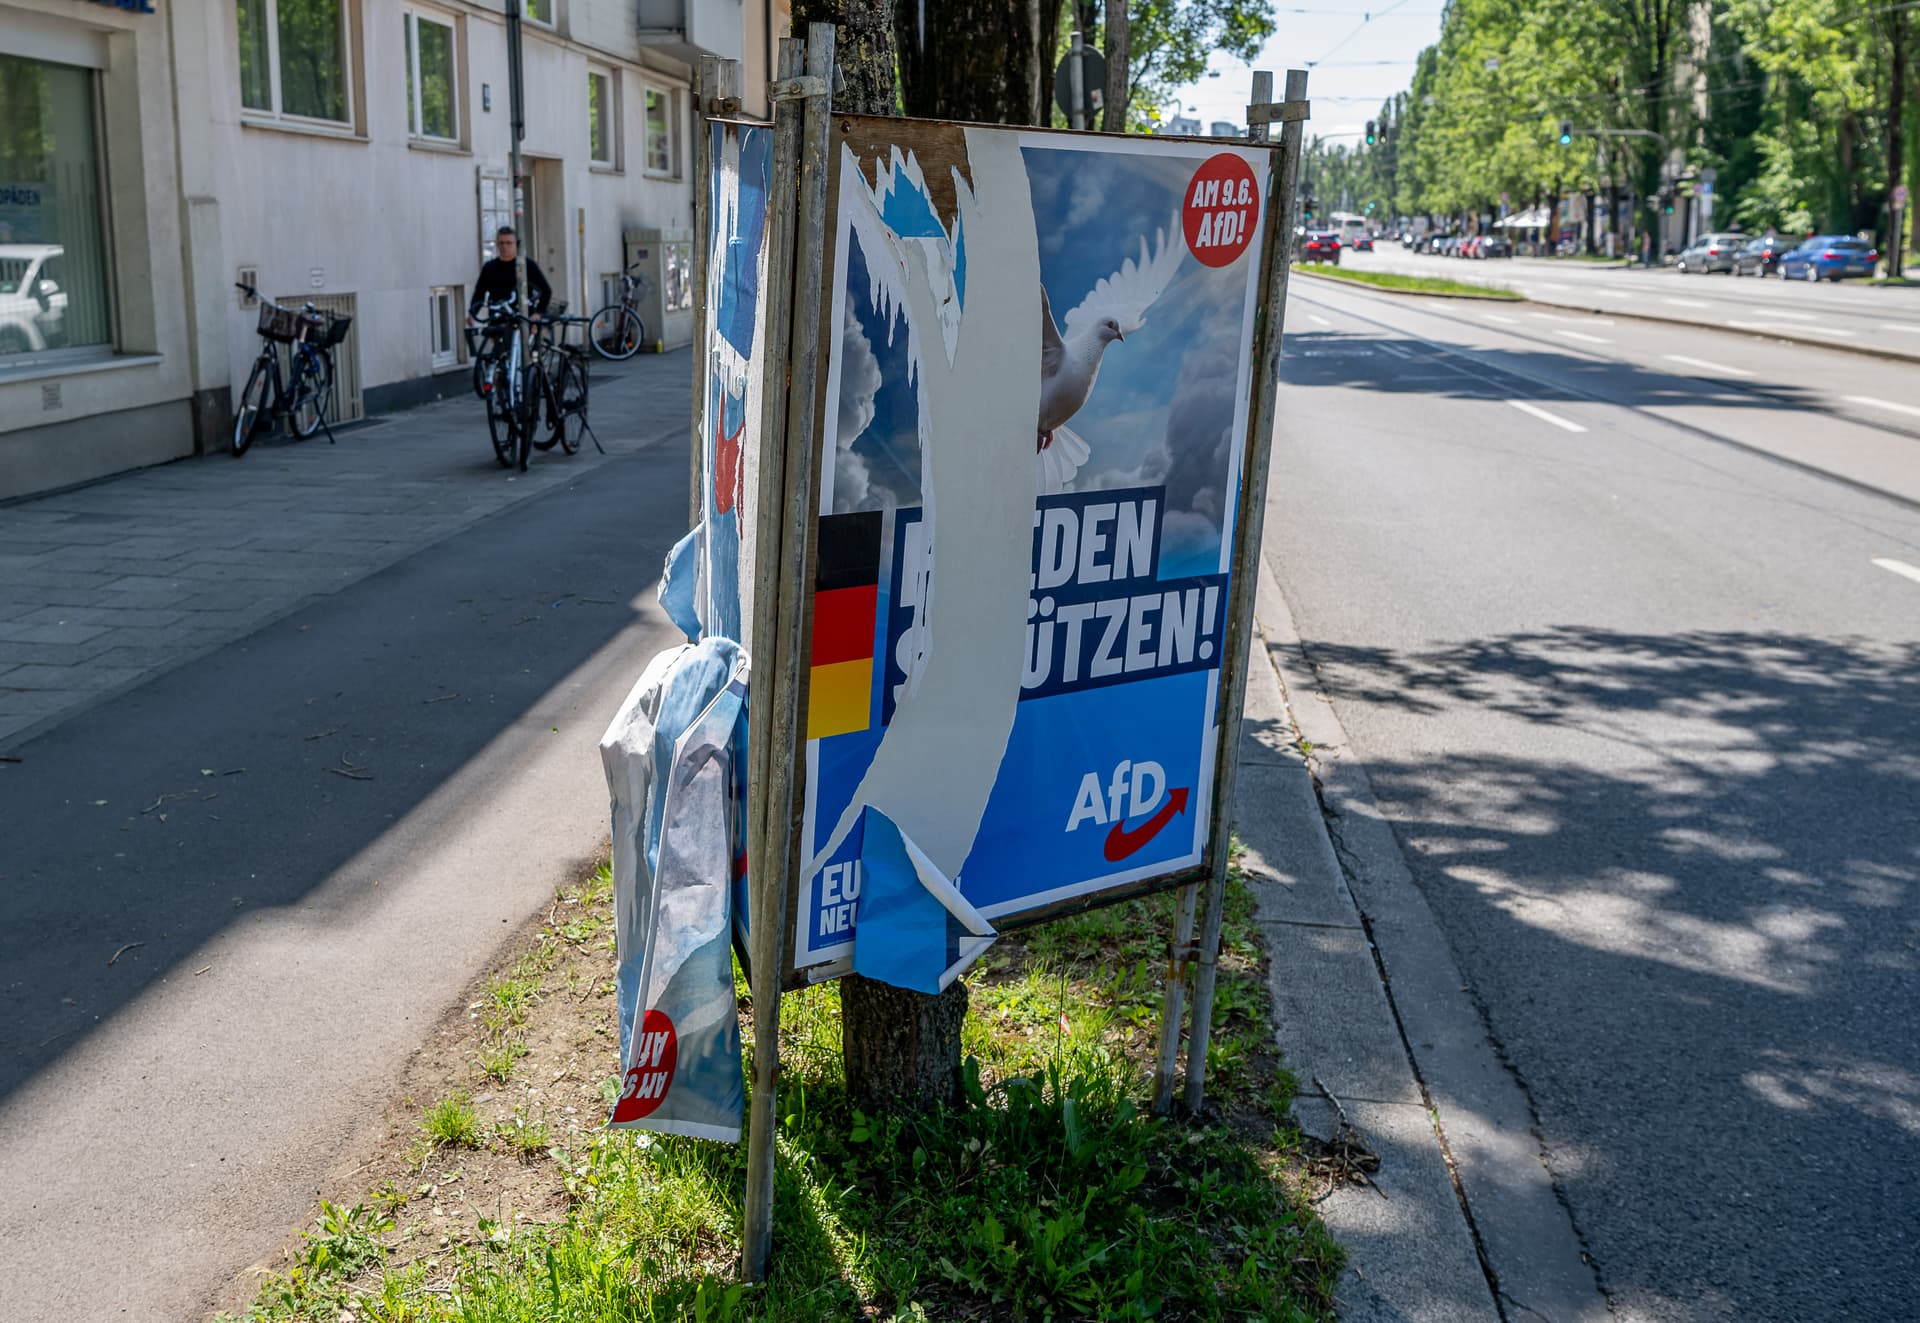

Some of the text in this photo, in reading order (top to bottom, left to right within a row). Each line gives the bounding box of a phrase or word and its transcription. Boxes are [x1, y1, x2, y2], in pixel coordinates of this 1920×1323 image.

[1191, 178, 1253, 209] AM 9.6.
[1195, 210, 1247, 248] AfD!
[1064, 760, 1166, 833] AfD
[635, 1071, 669, 1099] AM
